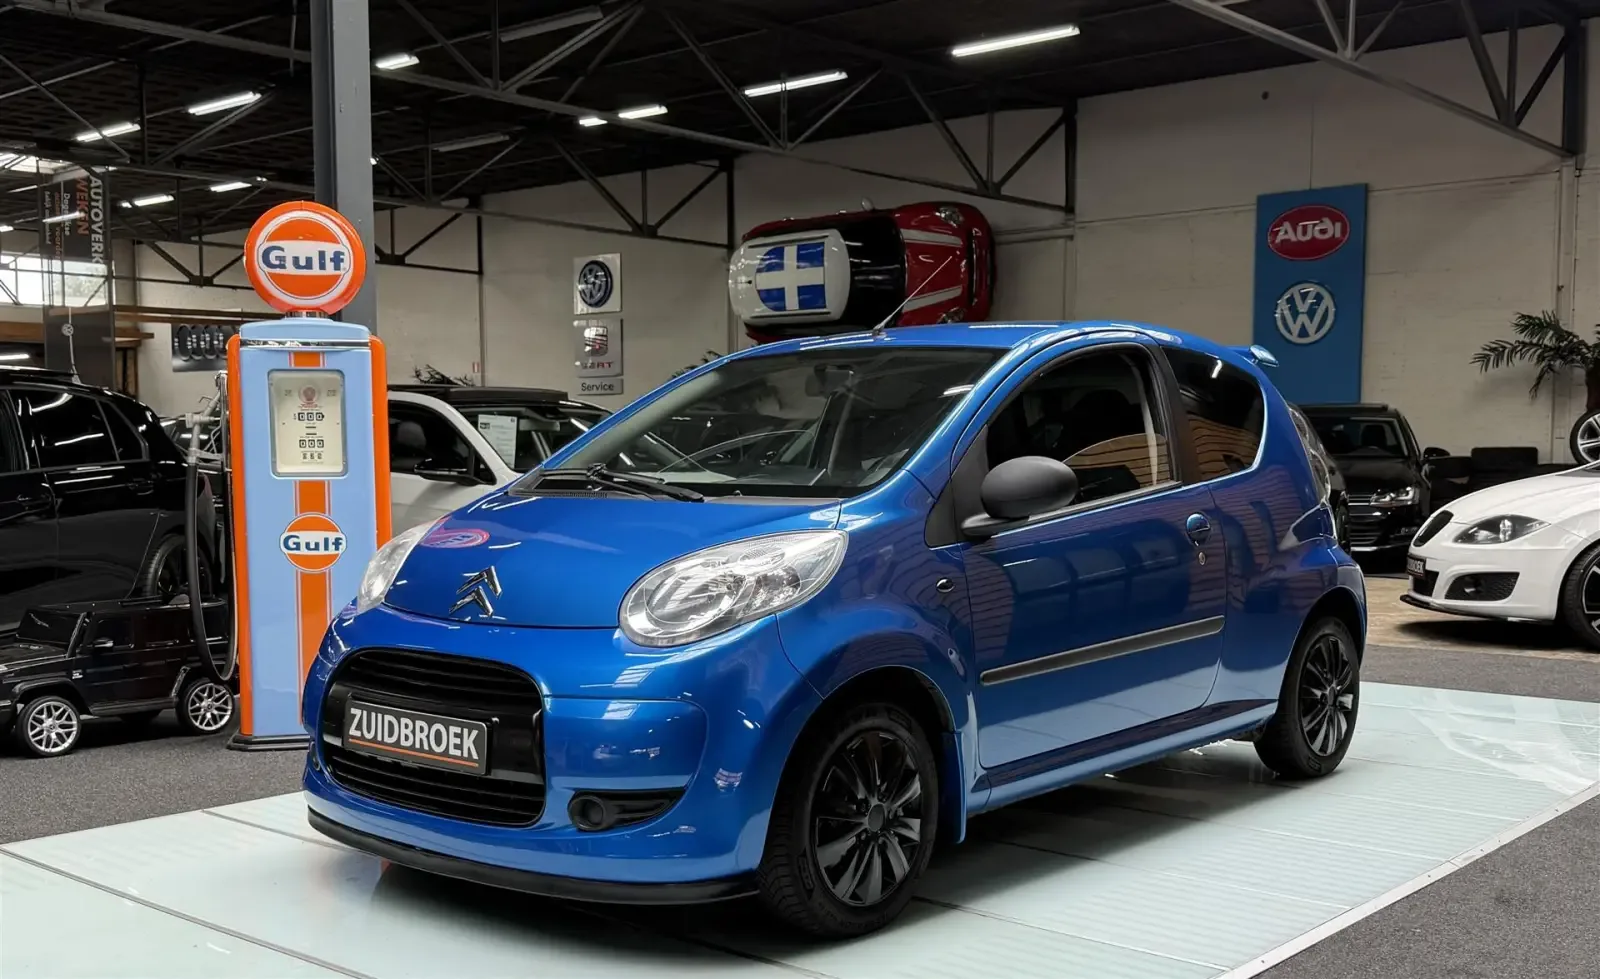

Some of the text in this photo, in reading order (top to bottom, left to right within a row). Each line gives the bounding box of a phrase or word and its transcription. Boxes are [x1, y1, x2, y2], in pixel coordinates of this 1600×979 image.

[262, 245, 345, 271] Gulf
[581, 382, 614, 391] Service
[283, 535, 343, 551] Gulf
[349, 707, 479, 760] ZUIDBROEK
